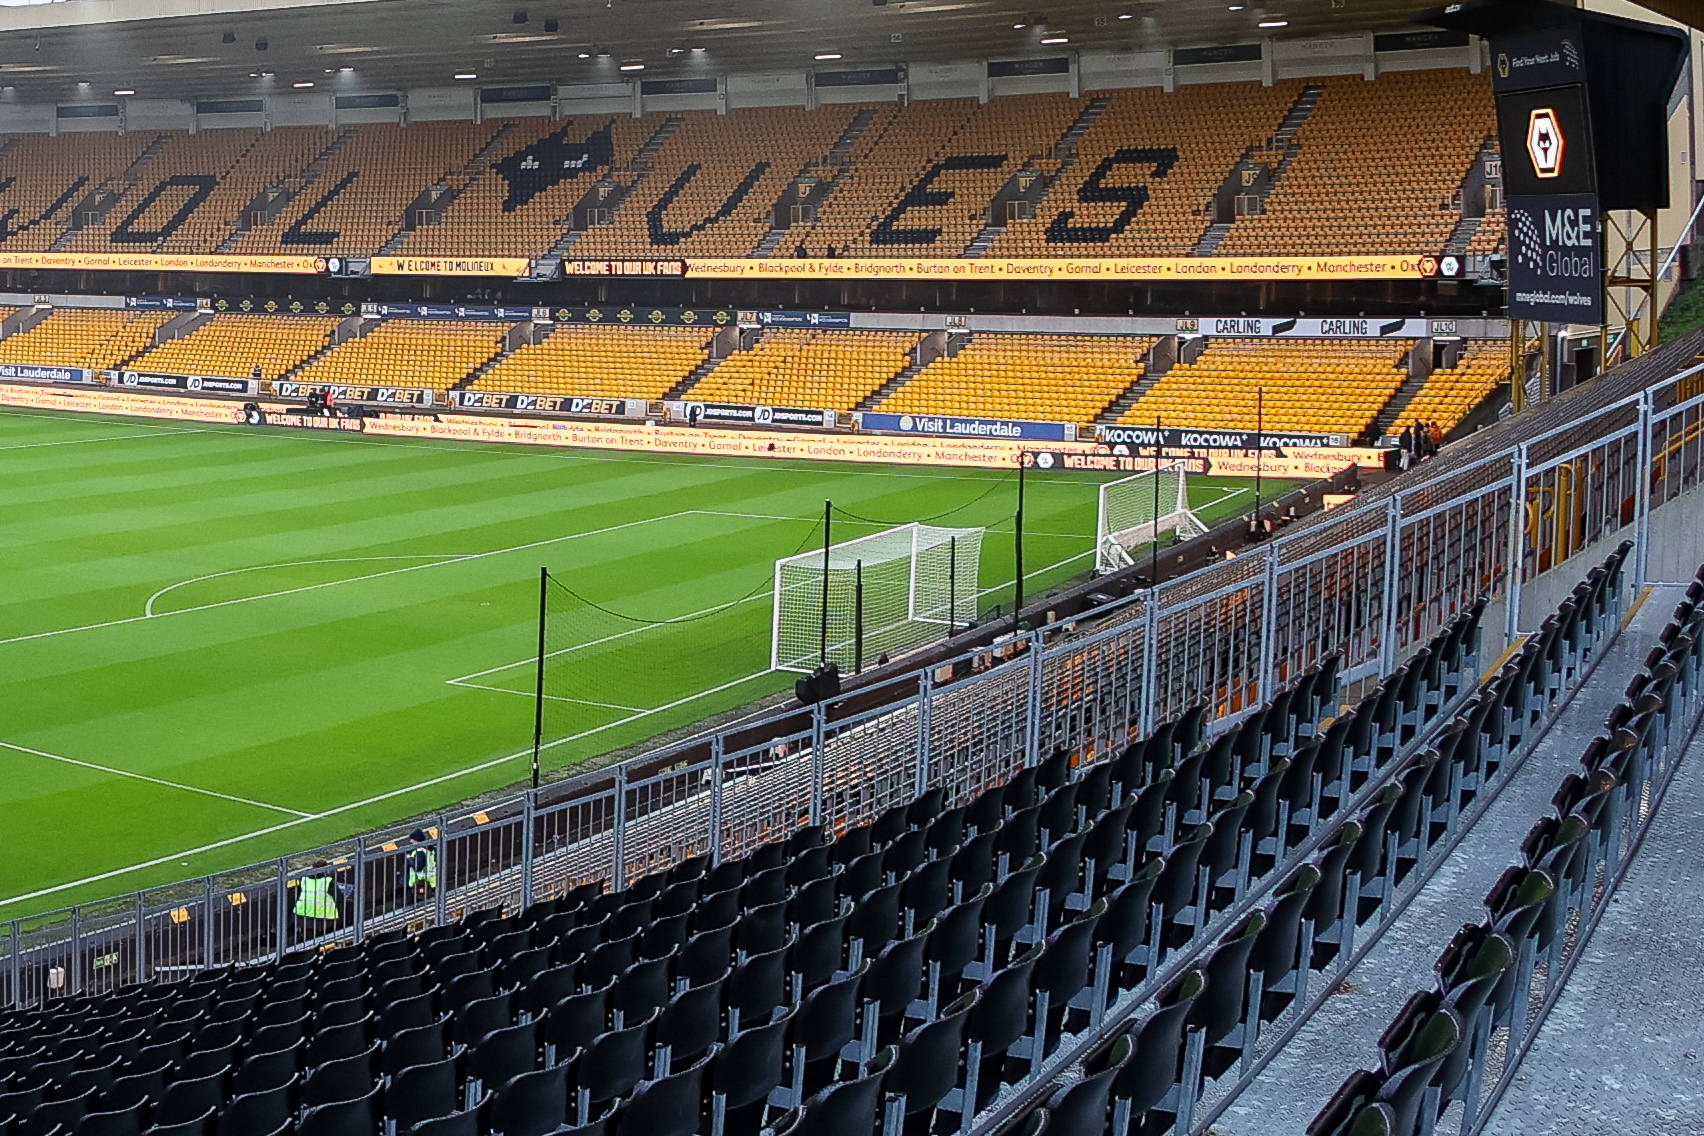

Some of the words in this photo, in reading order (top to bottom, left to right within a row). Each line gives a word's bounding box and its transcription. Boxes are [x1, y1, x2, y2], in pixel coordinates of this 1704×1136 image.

[1544, 208, 1593, 247] M&E
[14, 255, 33, 264] Trent
[42, 256, 76, 266] Daventry
[118, 257, 153, 266] Leicester
[161, 258, 188, 267] London
[196, 258, 241, 269] Londonderry
[249, 259, 294, 269] Manchester
[397, 259, 441, 272] WELCOME
[443, 260, 453, 272] TO
[455, 261, 494, 272] MOLINEUX
[565, 261, 609, 275] WELCOME
[610, 262, 622, 275] TO
[623, 262, 641, 275] OUR
[643, 262, 656, 275] UK
[657, 262, 682, 275] FANS
[758, 263, 805, 274] Blackpool
[808, 263, 816, 273] &
[819, 263, 844, 275] Fylde
[854, 263, 906, 276] Bridgnorth
[917, 263, 949, 273] Burton
[953, 265, 965, 273] on
[968, 263, 995, 273] Trent
[1006, 263, 1054, 277] Daventry
[1114, 263, 1163, 274] Leicester
[1175, 262, 1217, 274] London
[1230, 262, 1302, 276] Londonderry
[1316, 261, 1386, 273] Manchester
[1546, 250, 1594, 278] Global
[1515, 290, 1592, 306] mneglobal.com/wolves
[1215, 319, 1261, 334] CARLING
[1321, 319, 1368, 335] CARLING
[18, 367, 71, 380] Lauderdale
[99, 402, 123, 411] London
[131, 405, 174, 417] Londonderry
[180, 408, 223, 419] Manchester
[705, 407, 753, 418] JDSPORTS.COM
[774, 412, 823, 423] JDSPORTS.COM
[915, 417, 943, 433] Visit
[946, 420, 1022, 438] Lauderdale
[266, 414, 302, 426] WELCOME
[303, 416, 312, 427] TO
[313, 416, 327, 428] OUR
[328, 417, 339, 429] UK
[340, 418, 361, 431] FANS
[369, 421, 420, 433] Wednesbury
[430, 425, 472, 437] Blackpool
[473, 427, 480, 436] &
[482, 428, 505, 440] Fylde
[515, 430, 562, 442] Bridgnorth
[572, 434, 603, 444] Burton
[606, 436, 618, 445] on
[620, 435, 644, 446] Trent
[654, 438, 698, 451] Daventry
[752, 443, 796, 454] Leiester
[807, 445, 846, 456] London
[857, 448, 922, 461] Londonderry
[935, 451, 997, 463] Manchester
[1063, 454, 1118, 470] WELCOME
[1119, 456, 1132, 470] TO
[1134, 457, 1156, 471] OUR
[1217, 460, 1289, 475] Wednesbury
